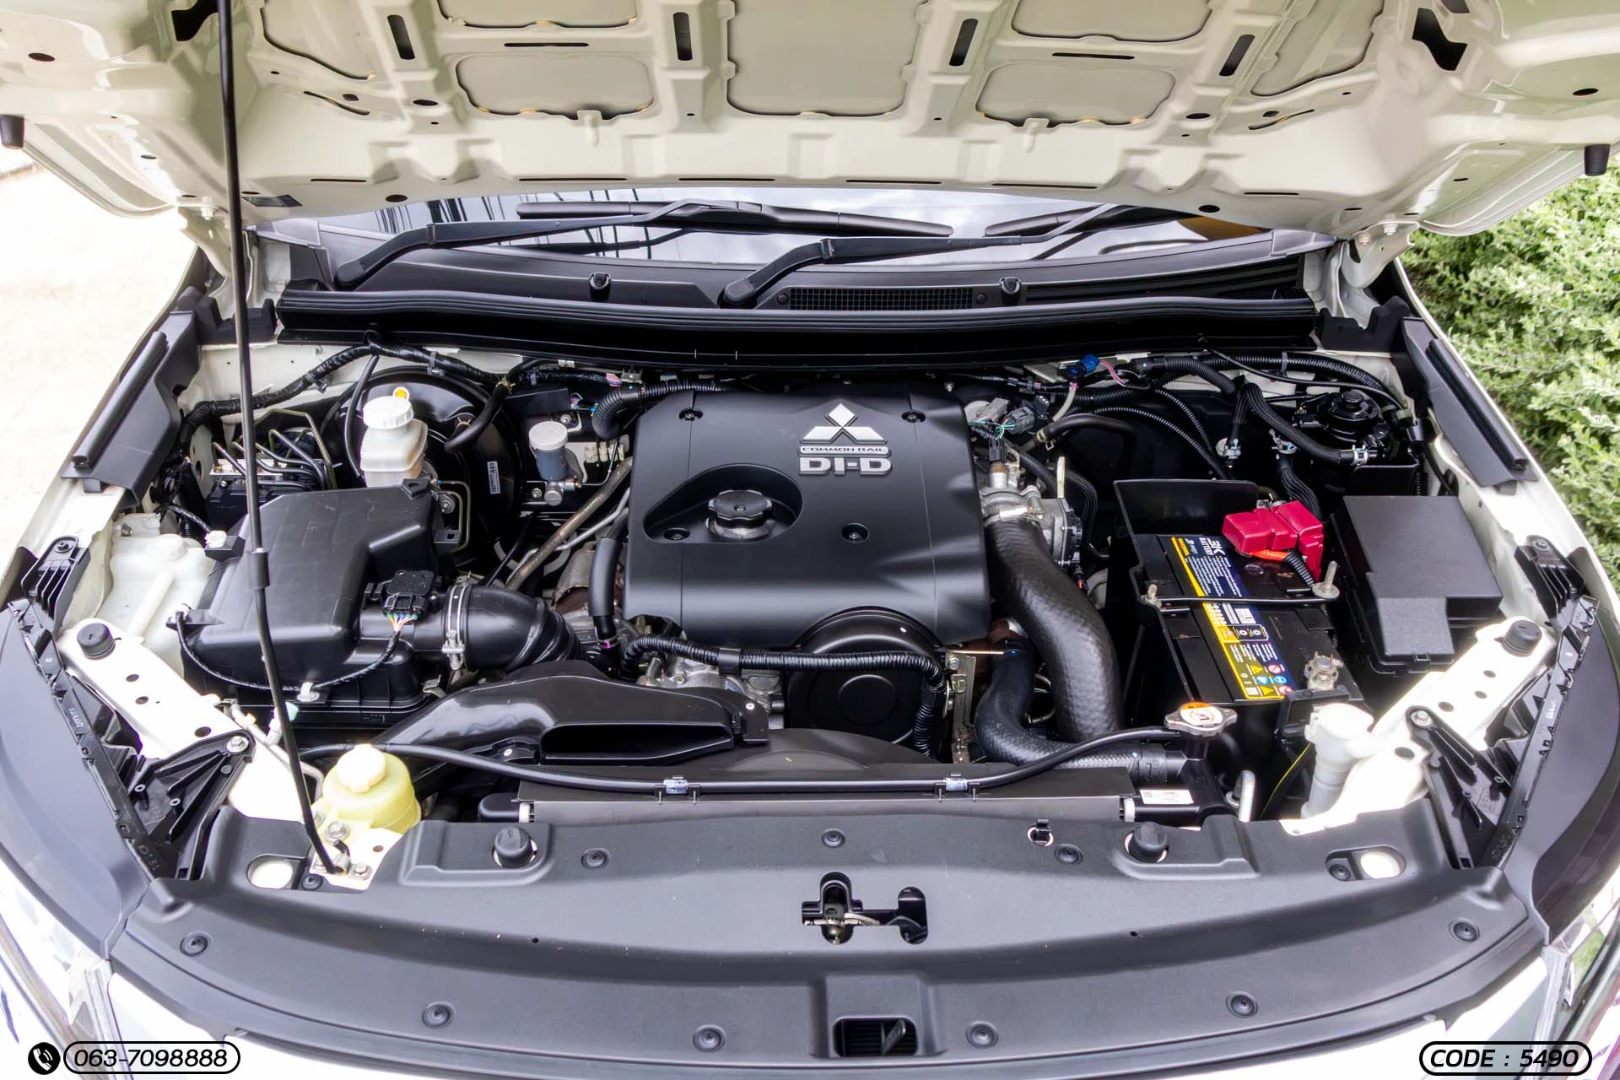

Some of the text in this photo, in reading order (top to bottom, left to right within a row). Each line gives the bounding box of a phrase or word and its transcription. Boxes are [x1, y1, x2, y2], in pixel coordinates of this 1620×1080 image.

[799, 457, 893, 476] DI-D
[1199, 537, 1214, 556] BATTERY
[1206, 537, 1226, 556] 3K
